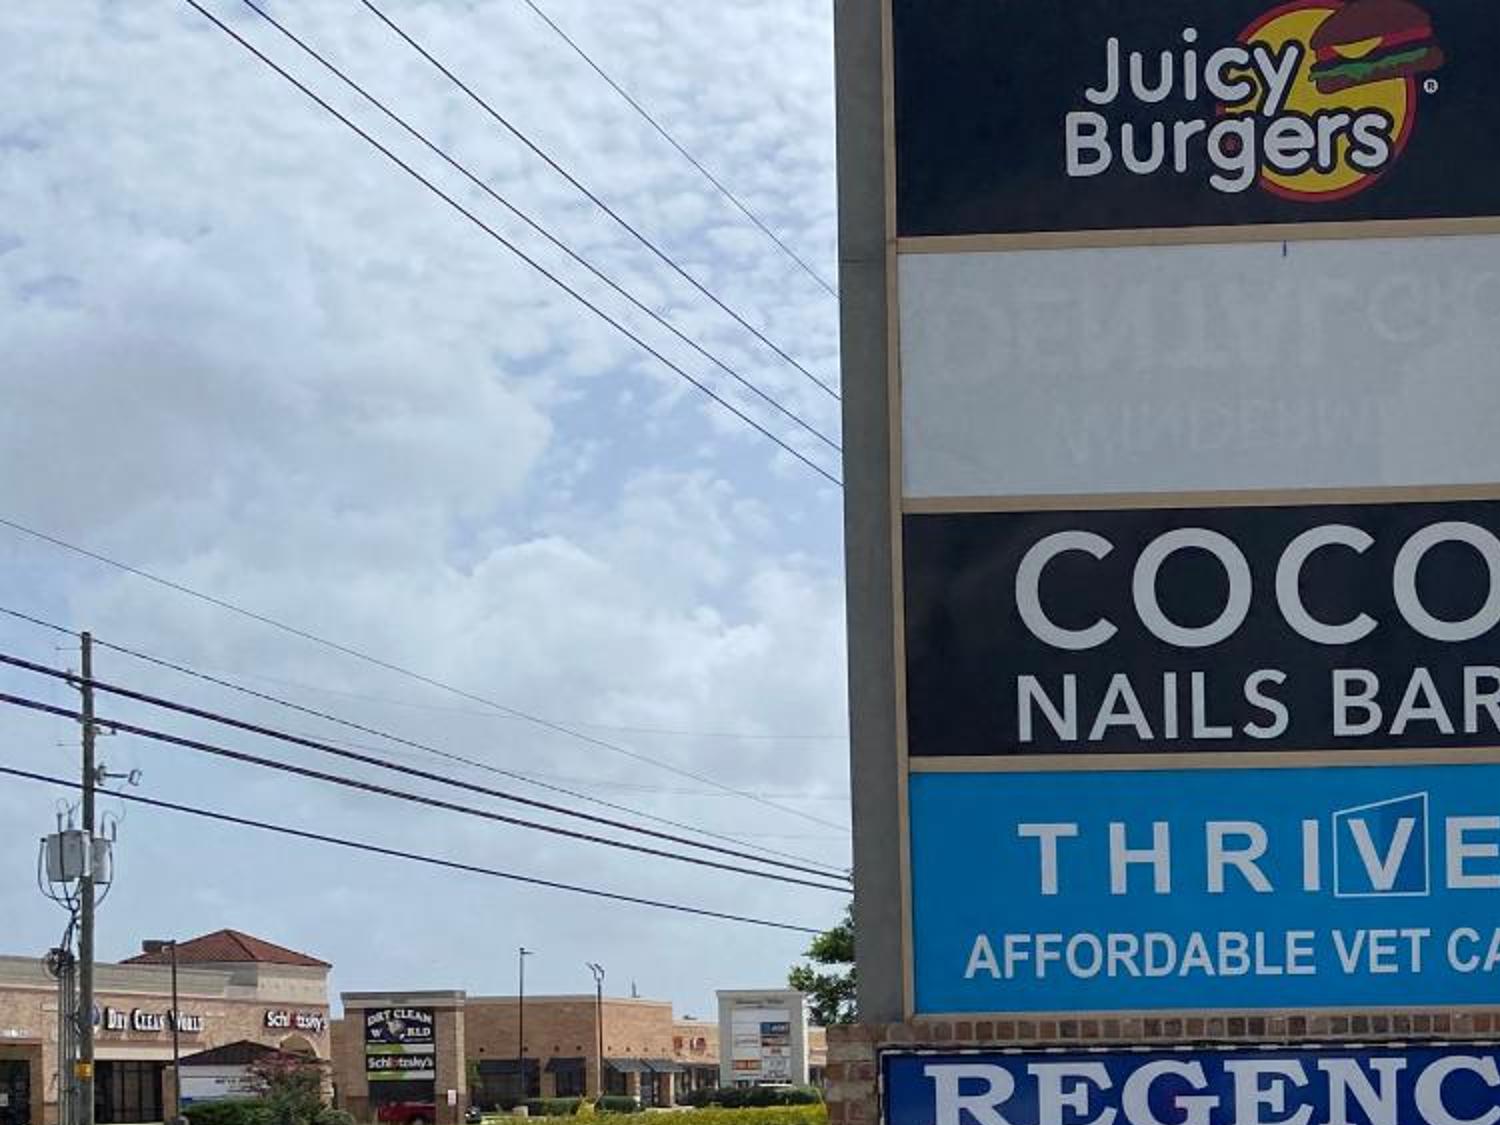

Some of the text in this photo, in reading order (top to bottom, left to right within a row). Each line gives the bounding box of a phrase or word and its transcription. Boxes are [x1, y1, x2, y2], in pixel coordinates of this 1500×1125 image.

[1085, 27, 1300, 118] Juicy
[1065, 110, 1391, 193] Burgers
[1016, 668, 1290, 742] NAILS
[964, 929, 1317, 979] AFFORDABLE
[1331, 927, 1431, 975] VET
